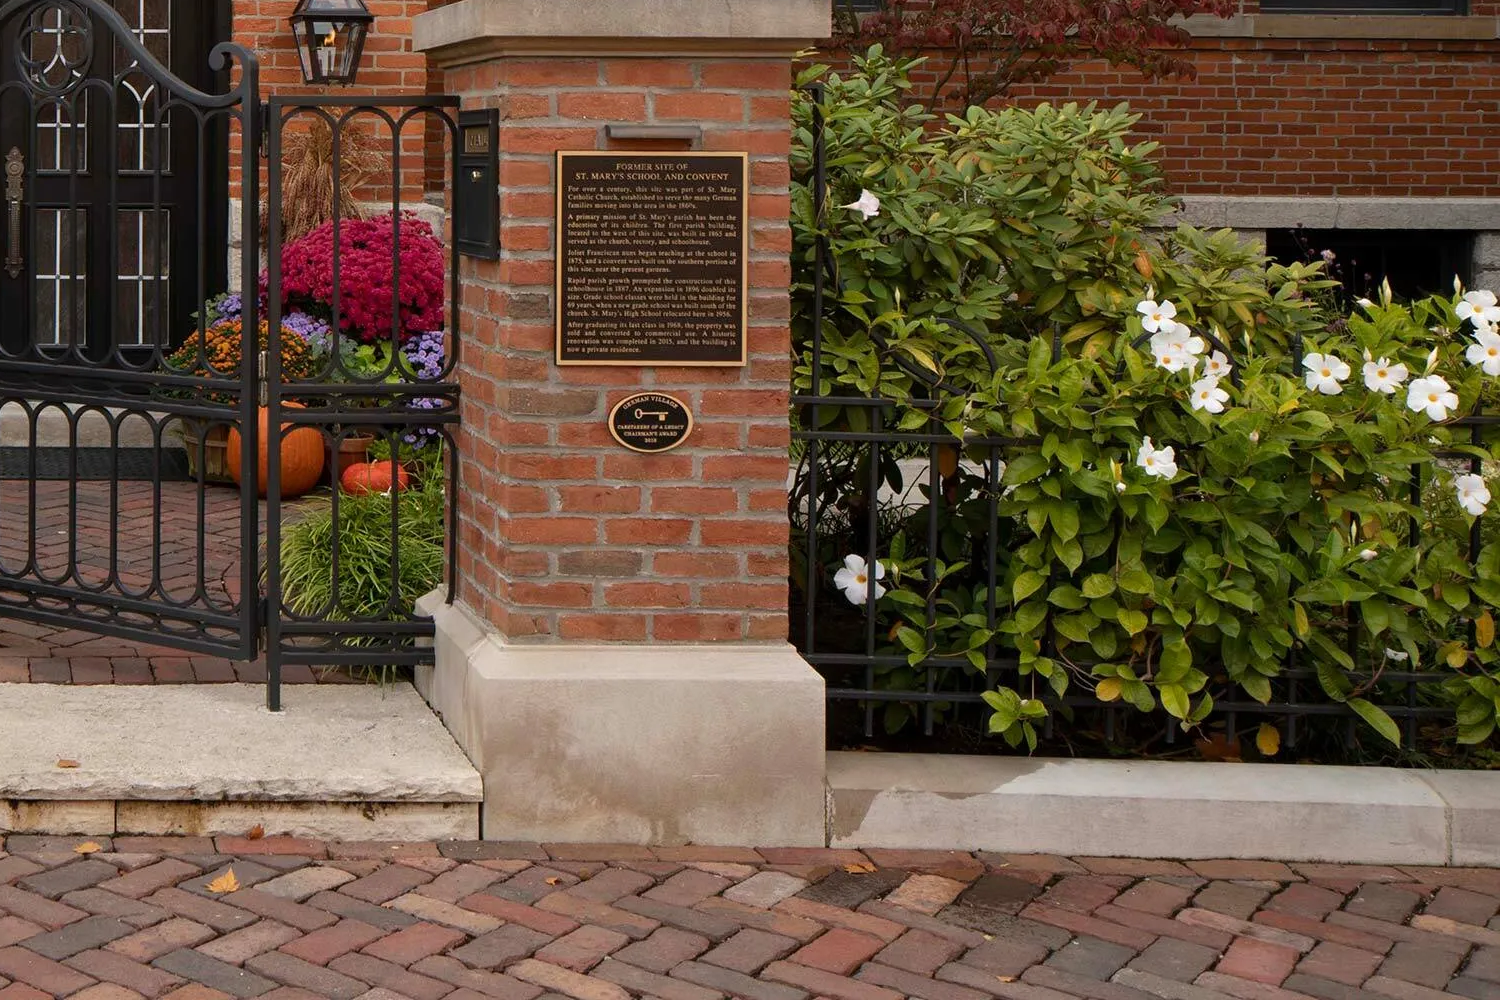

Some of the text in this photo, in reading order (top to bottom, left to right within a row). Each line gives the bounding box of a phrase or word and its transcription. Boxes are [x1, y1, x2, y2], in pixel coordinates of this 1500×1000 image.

[685, 222, 705, 230] parish
[644, 286, 675, 294] expansion
[623, 396, 678, 409] GERMAN VILLAGE
